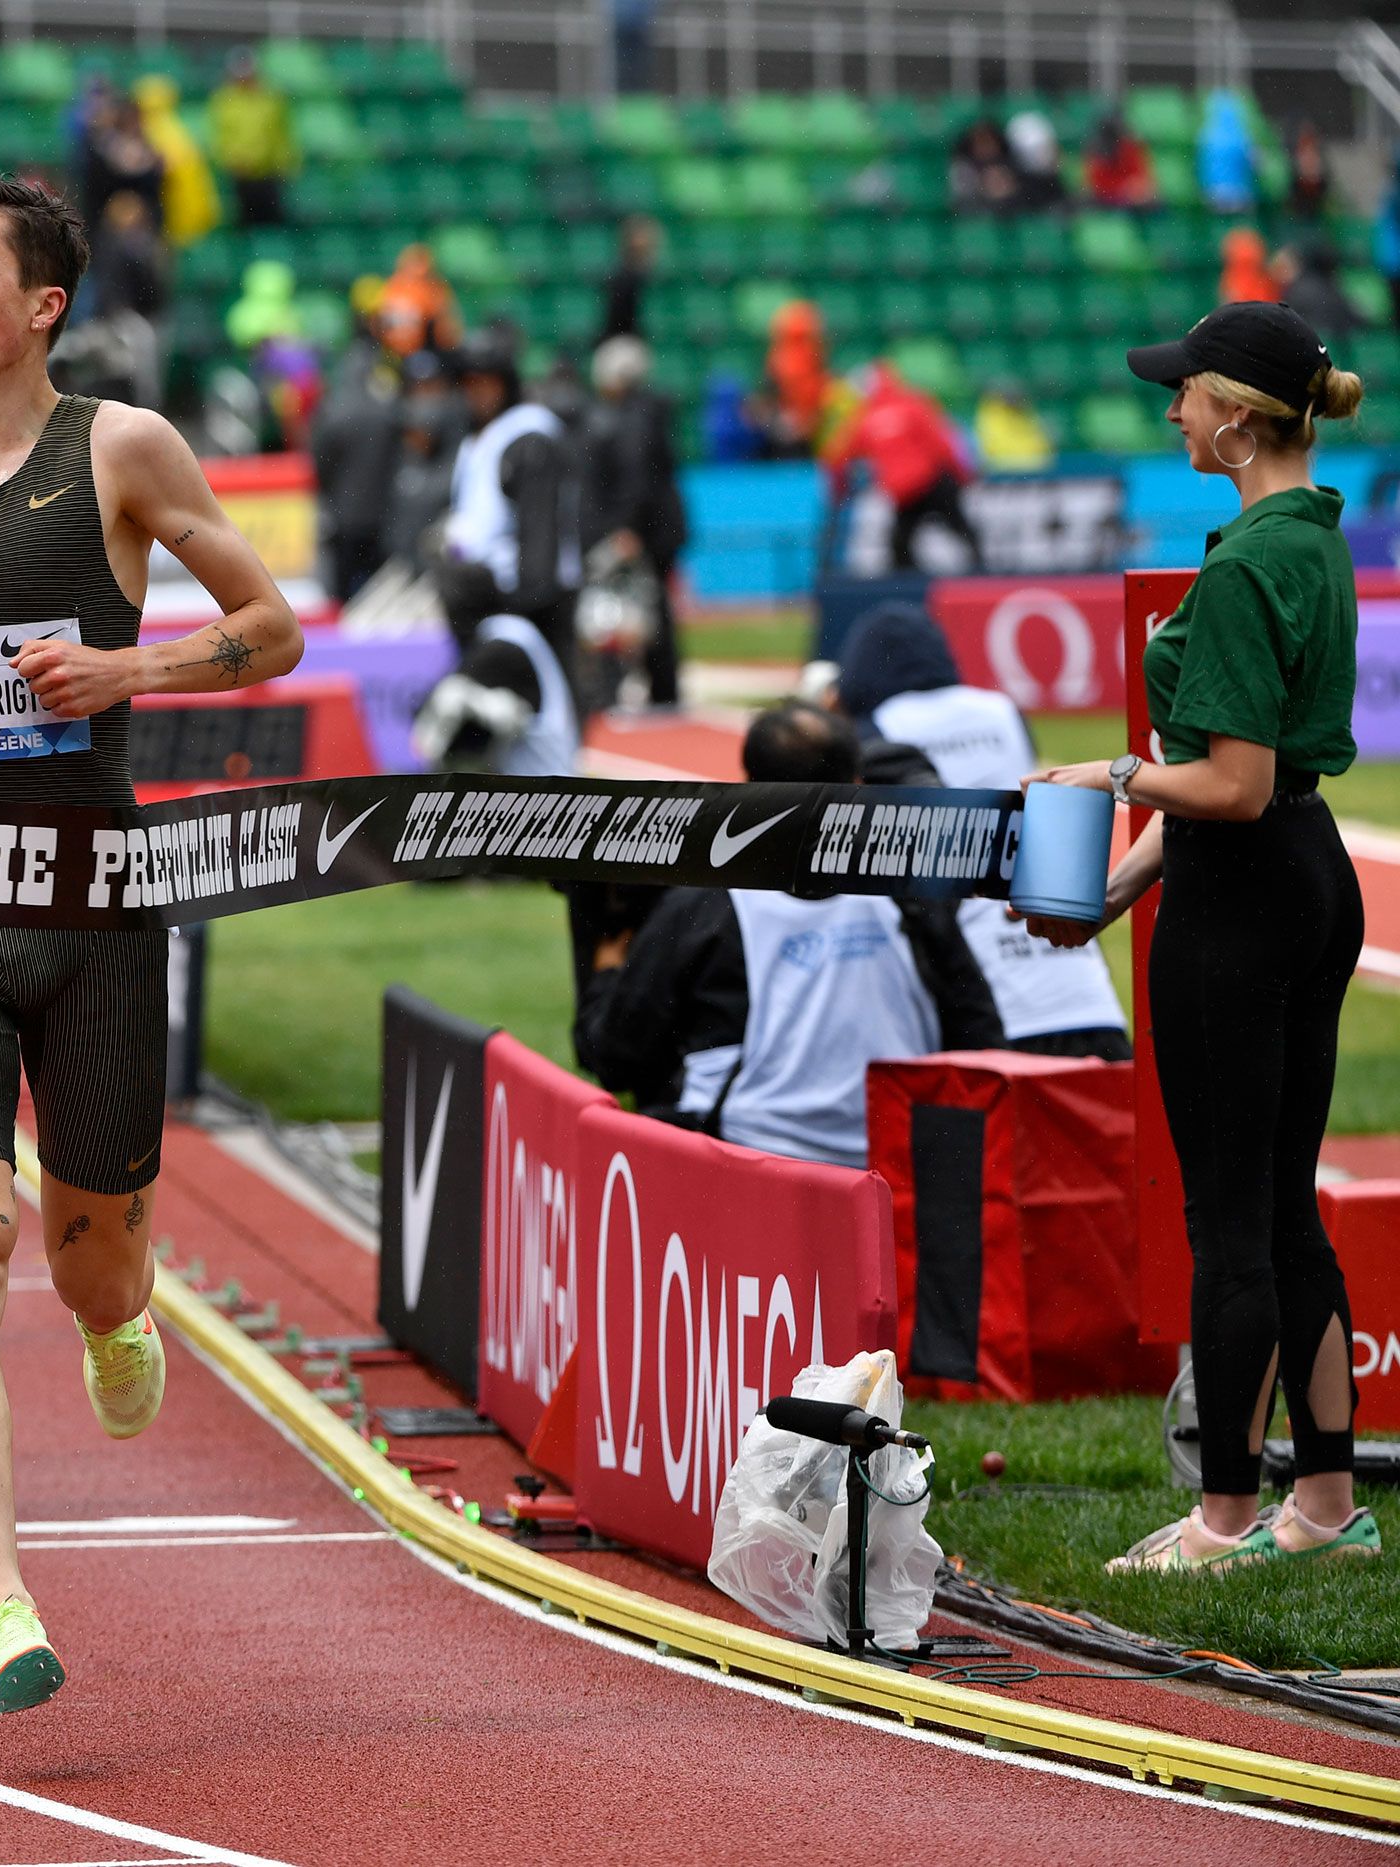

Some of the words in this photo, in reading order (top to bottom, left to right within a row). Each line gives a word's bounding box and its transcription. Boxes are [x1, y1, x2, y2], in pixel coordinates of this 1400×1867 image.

[174, 529, 195, 546] fast
[87, 813, 234, 908] PREFONTAINE
[239, 802, 302, 888] CLASSIC
[393, 792, 455, 863] THE
[435, 791, 612, 860] PREFONTAINE
[593, 797, 704, 866] CLASSIC
[810, 803, 866, 875] THE
[858, 804, 1000, 878] PREFONTAINE
